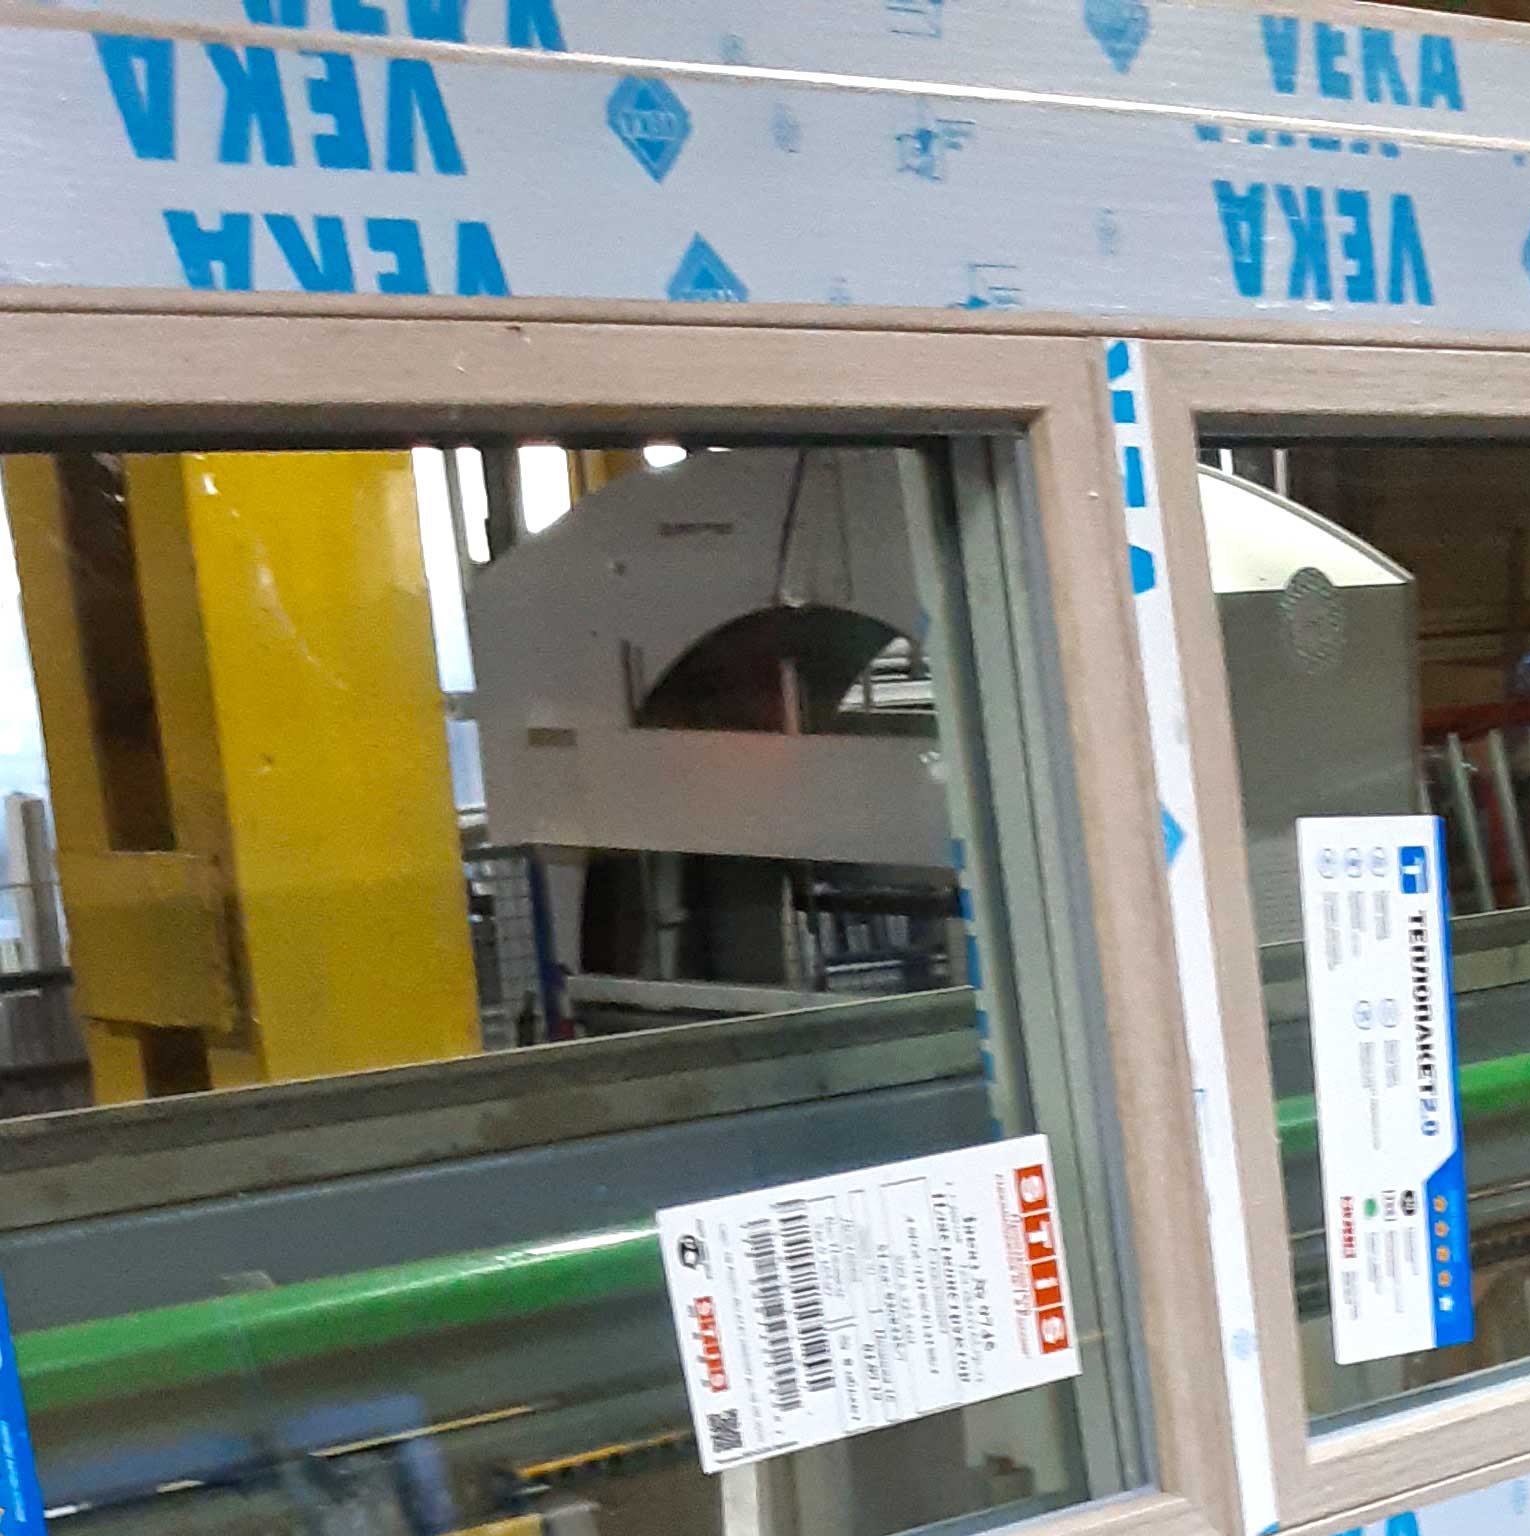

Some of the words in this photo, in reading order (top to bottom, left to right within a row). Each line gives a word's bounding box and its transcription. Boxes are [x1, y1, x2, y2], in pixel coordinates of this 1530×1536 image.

[92, 30, 467, 176] VEKA
[1260, 14, 1464, 112] VEKA
[1212, 179, 1434, 307] VEKA
[1407, 909, 1437, 1096] ТЕПЛОПАКЕТ
